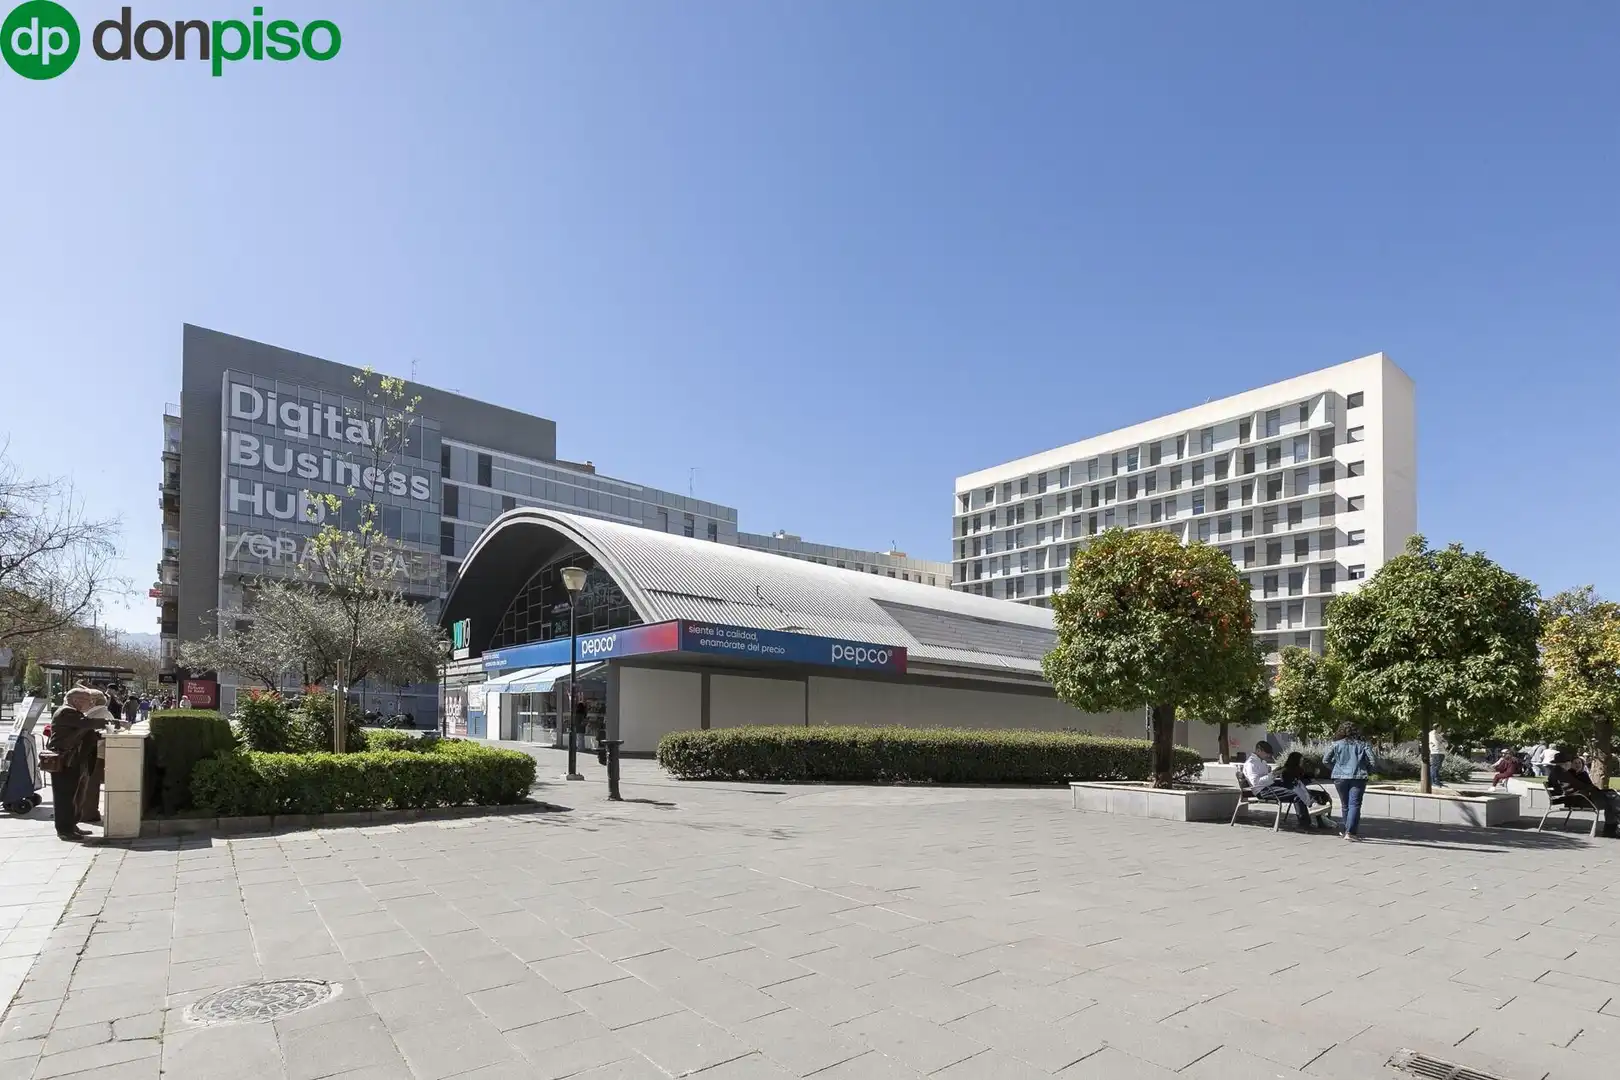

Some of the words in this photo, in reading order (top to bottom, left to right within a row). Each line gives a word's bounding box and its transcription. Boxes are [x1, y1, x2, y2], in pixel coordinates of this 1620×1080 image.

[231, 383, 385, 448] Digital
[230, 430, 430, 500] Business
[229, 479, 326, 524] Hub
[688, 624, 715, 636] siente
[716, 627, 725, 637] la
[726, 629, 759, 642] calidad,
[581, 636, 615, 659] pepco
[700, 638, 746, 651] enamórate
[747, 642, 760, 652] del
[761, 644, 786, 655] precio
[831, 644, 888, 665] pepco
